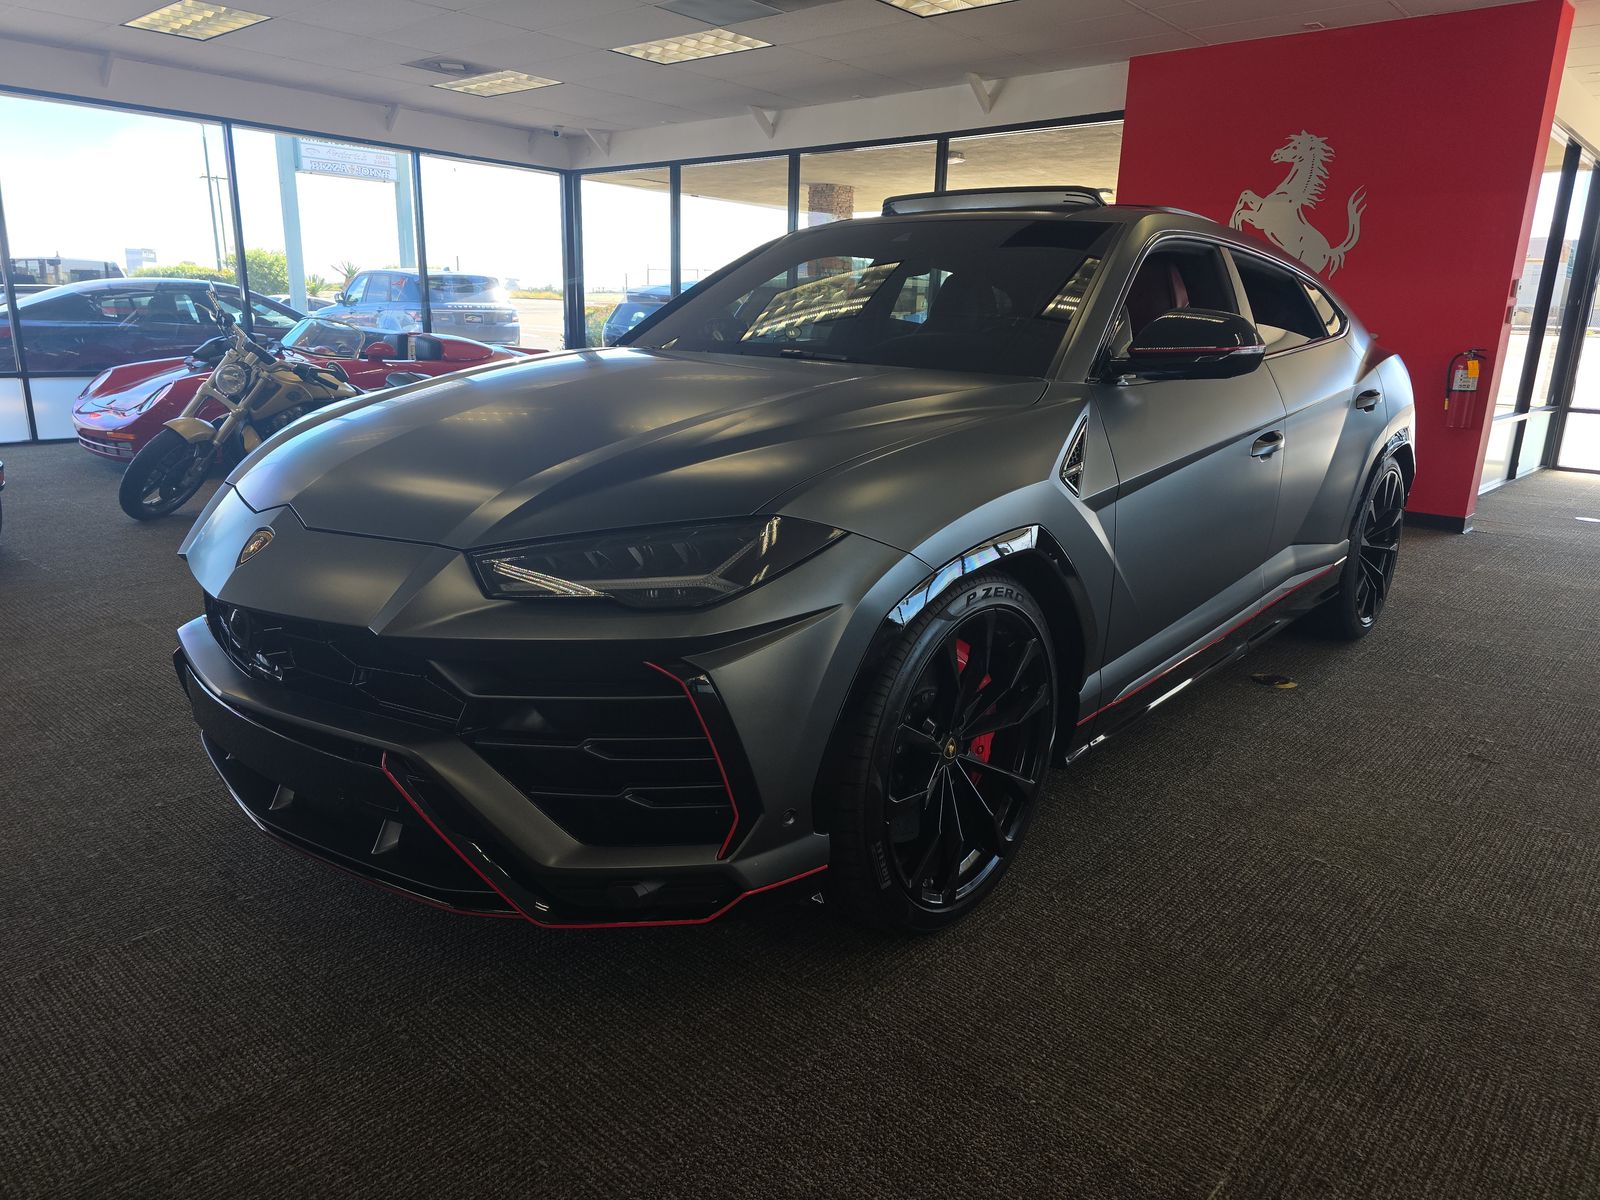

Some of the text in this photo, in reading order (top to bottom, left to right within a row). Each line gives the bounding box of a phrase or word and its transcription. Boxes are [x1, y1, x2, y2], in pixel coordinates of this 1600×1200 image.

[310, 160, 347, 173] PIZZA
[966, 586, 1024, 607] P ZERO
